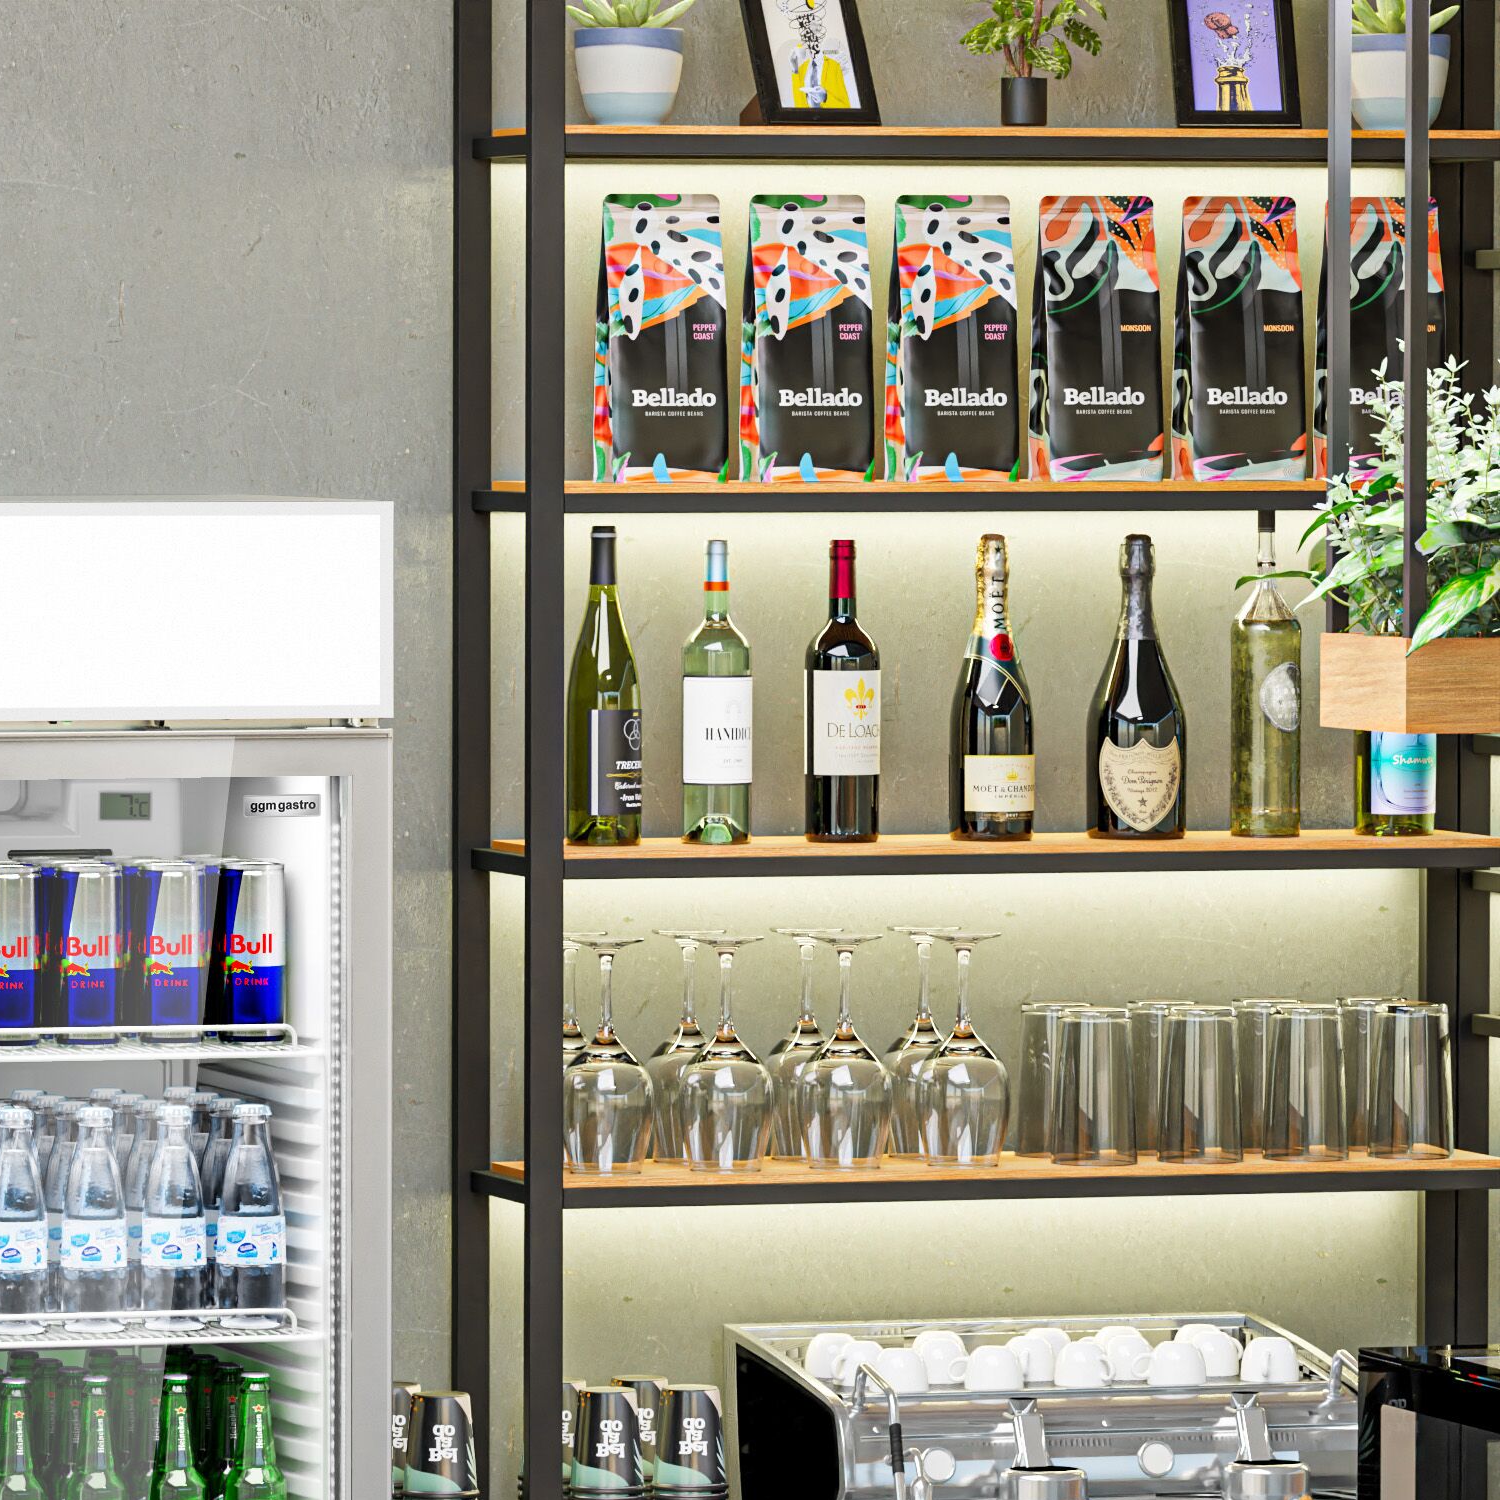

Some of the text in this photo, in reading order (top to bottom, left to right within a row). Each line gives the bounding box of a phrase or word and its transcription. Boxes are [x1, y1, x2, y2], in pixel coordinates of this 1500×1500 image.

[692, 323, 717, 332] PEPPER
[838, 323, 863, 332] PEPPER
[983, 323, 1008, 332] PEPPER
[1120, 324, 1152, 332] MONSOON
[1263, 324, 1295, 332] MONSOON
[693, 332, 714, 341] COAST
[839, 332, 860, 340] COAST
[984, 332, 1006, 340] COAST
[631, 387, 717, 407] Bellado
[778, 387, 863, 407] Bellado
[923, 387, 1008, 407] Bellado
[1063, 386, 1145, 406] Bellado
[1206, 386, 1288, 406] Bellado
[848, 722, 880, 738] LOAC
[1121, 775, 1138, 784] Dom
[250, 799, 316, 813] ggm gastro
[66, 936, 110, 958] Bull
[149, 934, 192, 956] Bull
[230, 934, 272, 954] Bull
[70, 979, 106, 989] DRINK
[154, 978, 189, 988] DRINK
[235, 977, 269, 986] DRINK
[16, 1420, 24, 1456] Heineken
[178, 1416, 186, 1451] Heineken
